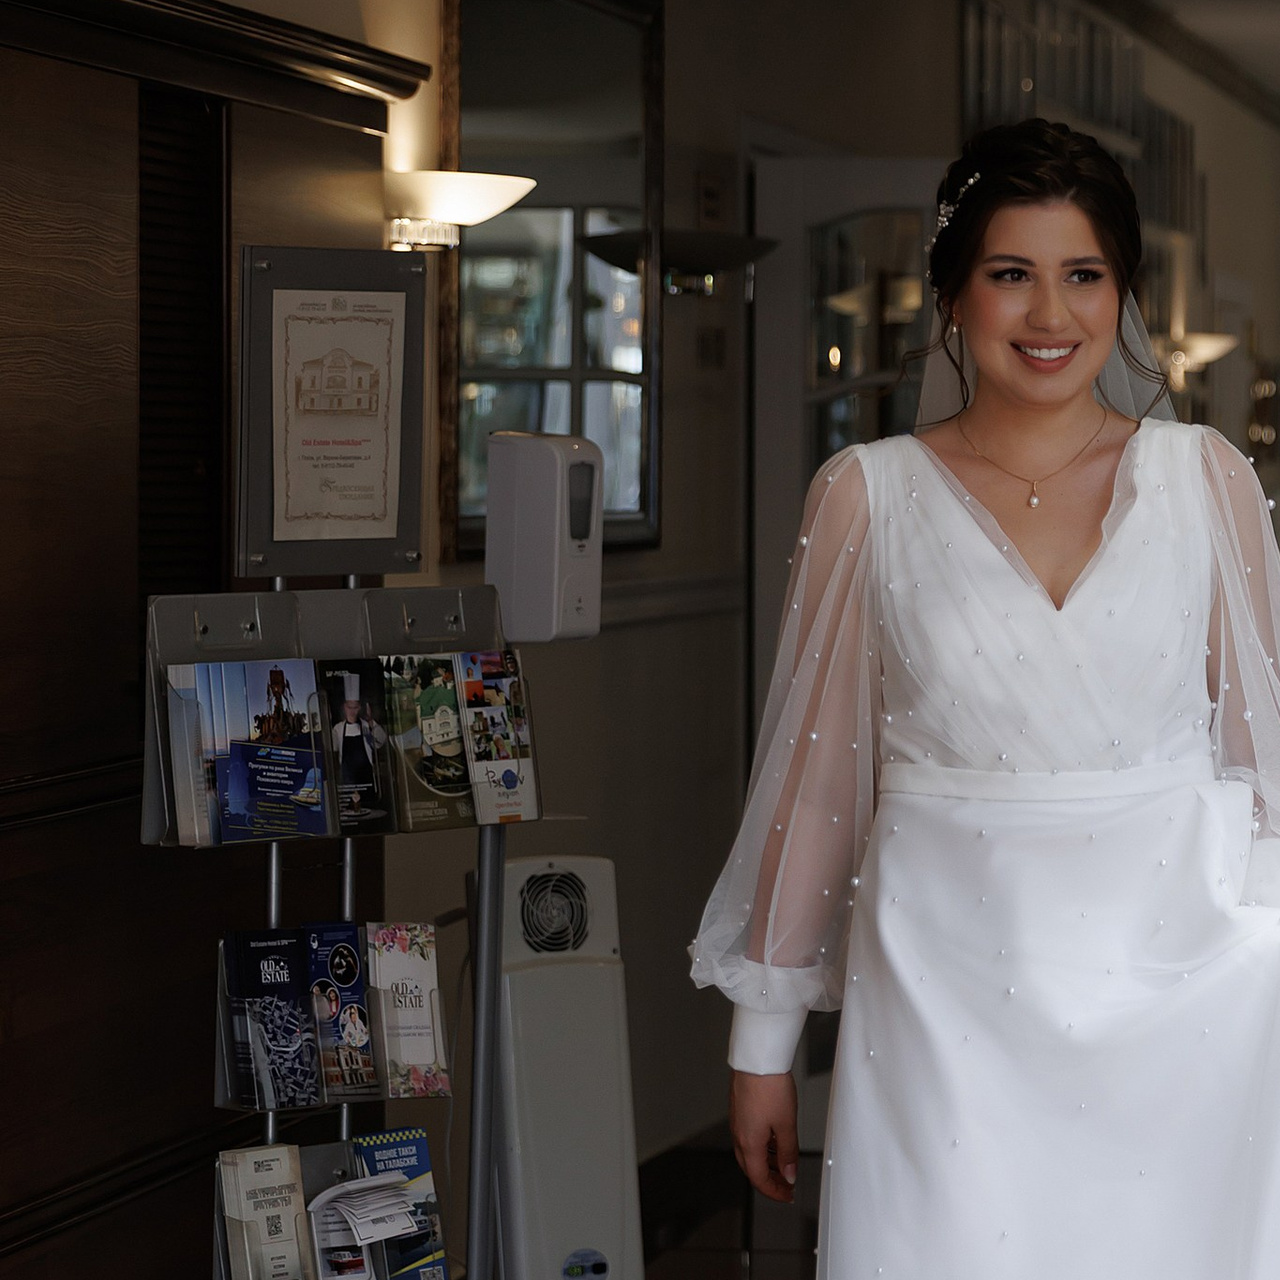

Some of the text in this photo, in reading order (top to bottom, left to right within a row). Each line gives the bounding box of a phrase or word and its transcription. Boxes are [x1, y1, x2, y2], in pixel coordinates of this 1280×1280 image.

[260, 960, 275, 972] OLD
[261, 970, 290, 984] ESTATE
[391, 982, 408, 995] OLD
[392, 994, 424, 1009] ESTATE
[376, 1161, 386, 1171] НА
